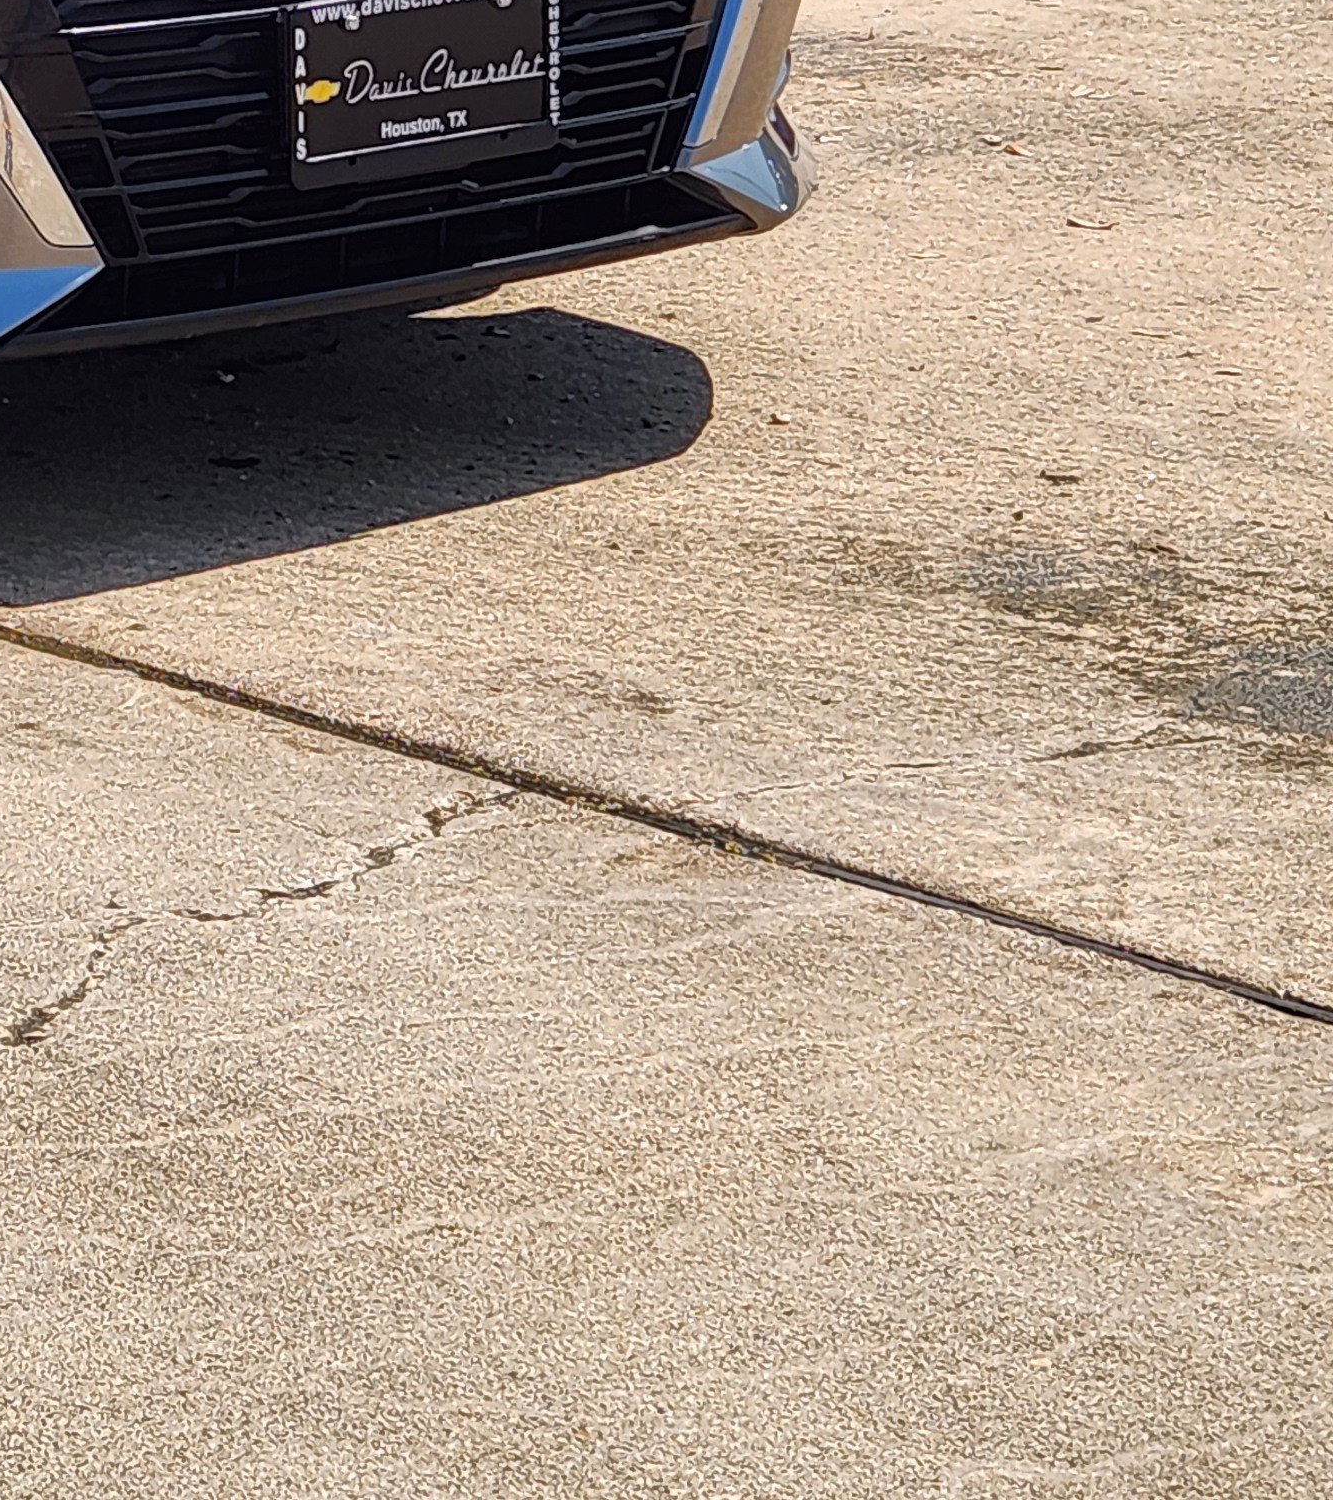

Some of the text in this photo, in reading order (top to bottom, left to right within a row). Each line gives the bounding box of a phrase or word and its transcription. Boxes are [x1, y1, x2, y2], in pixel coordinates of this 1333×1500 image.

[294, 27, 308, 161] DAVIS
[343, 48, 547, 104] Davis Chevrolet
[380, 109, 469, 139] Houston, TX
